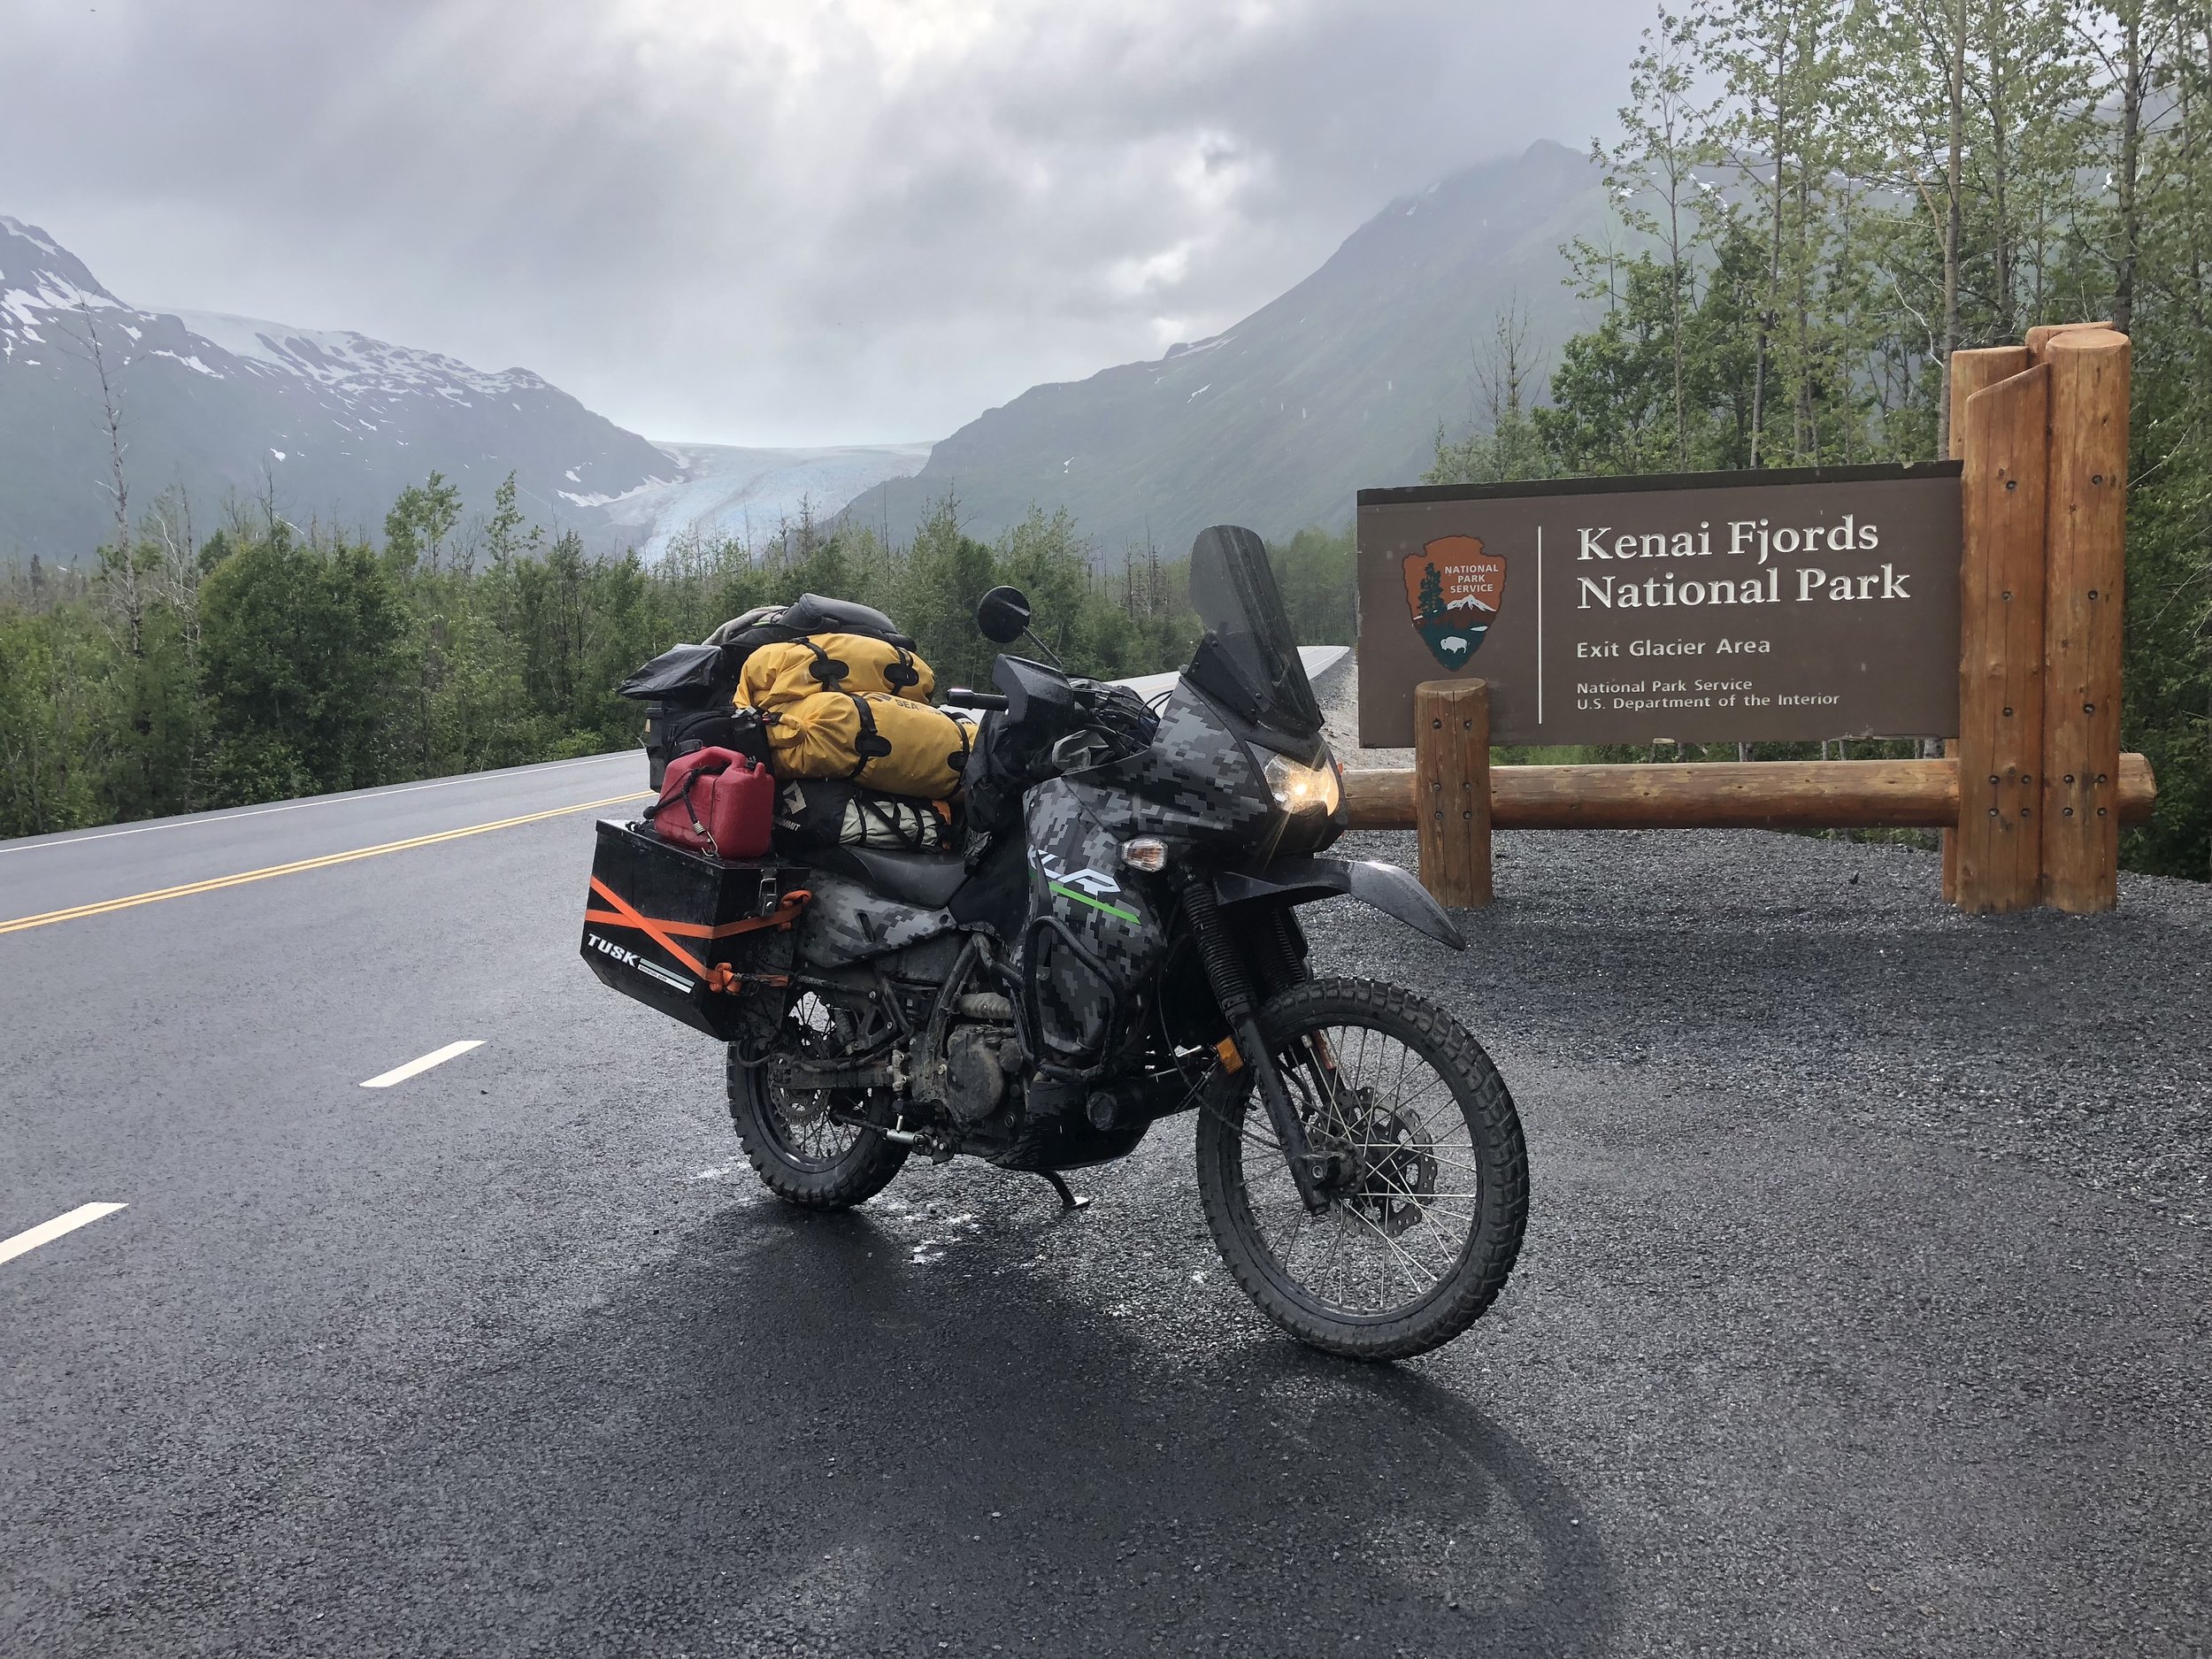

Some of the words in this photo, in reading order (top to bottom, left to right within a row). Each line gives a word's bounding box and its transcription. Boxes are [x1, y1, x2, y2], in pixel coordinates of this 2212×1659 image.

[1577, 521, 1712, 560] Kenai
[1727, 514, 1878, 565] Fjords
[1445, 565, 1499, 574] NATIONAL
[1457, 574, 1485, 583] PARK
[1450, 584, 1494, 593] SERVICE
[1577, 567, 1781, 609] National
[1795, 563, 1910, 602] Park
[1577, 641, 1619, 658] Exit
[1629, 639, 1706, 657] Glacier
[1716, 638, 1770, 654] Area
[1577, 680, 1645, 694] National
[1652, 680, 1686, 692] Park
[1694, 679, 1753, 691] Service
[1577, 698, 1606, 710] U.S.
[1613, 696, 1710, 711] Department
[1718, 695, 1736, 707] of
[1744, 695, 1770, 707] the
[1778, 693, 1840, 705] Interior
[588, 933, 639, 967] TUSK
